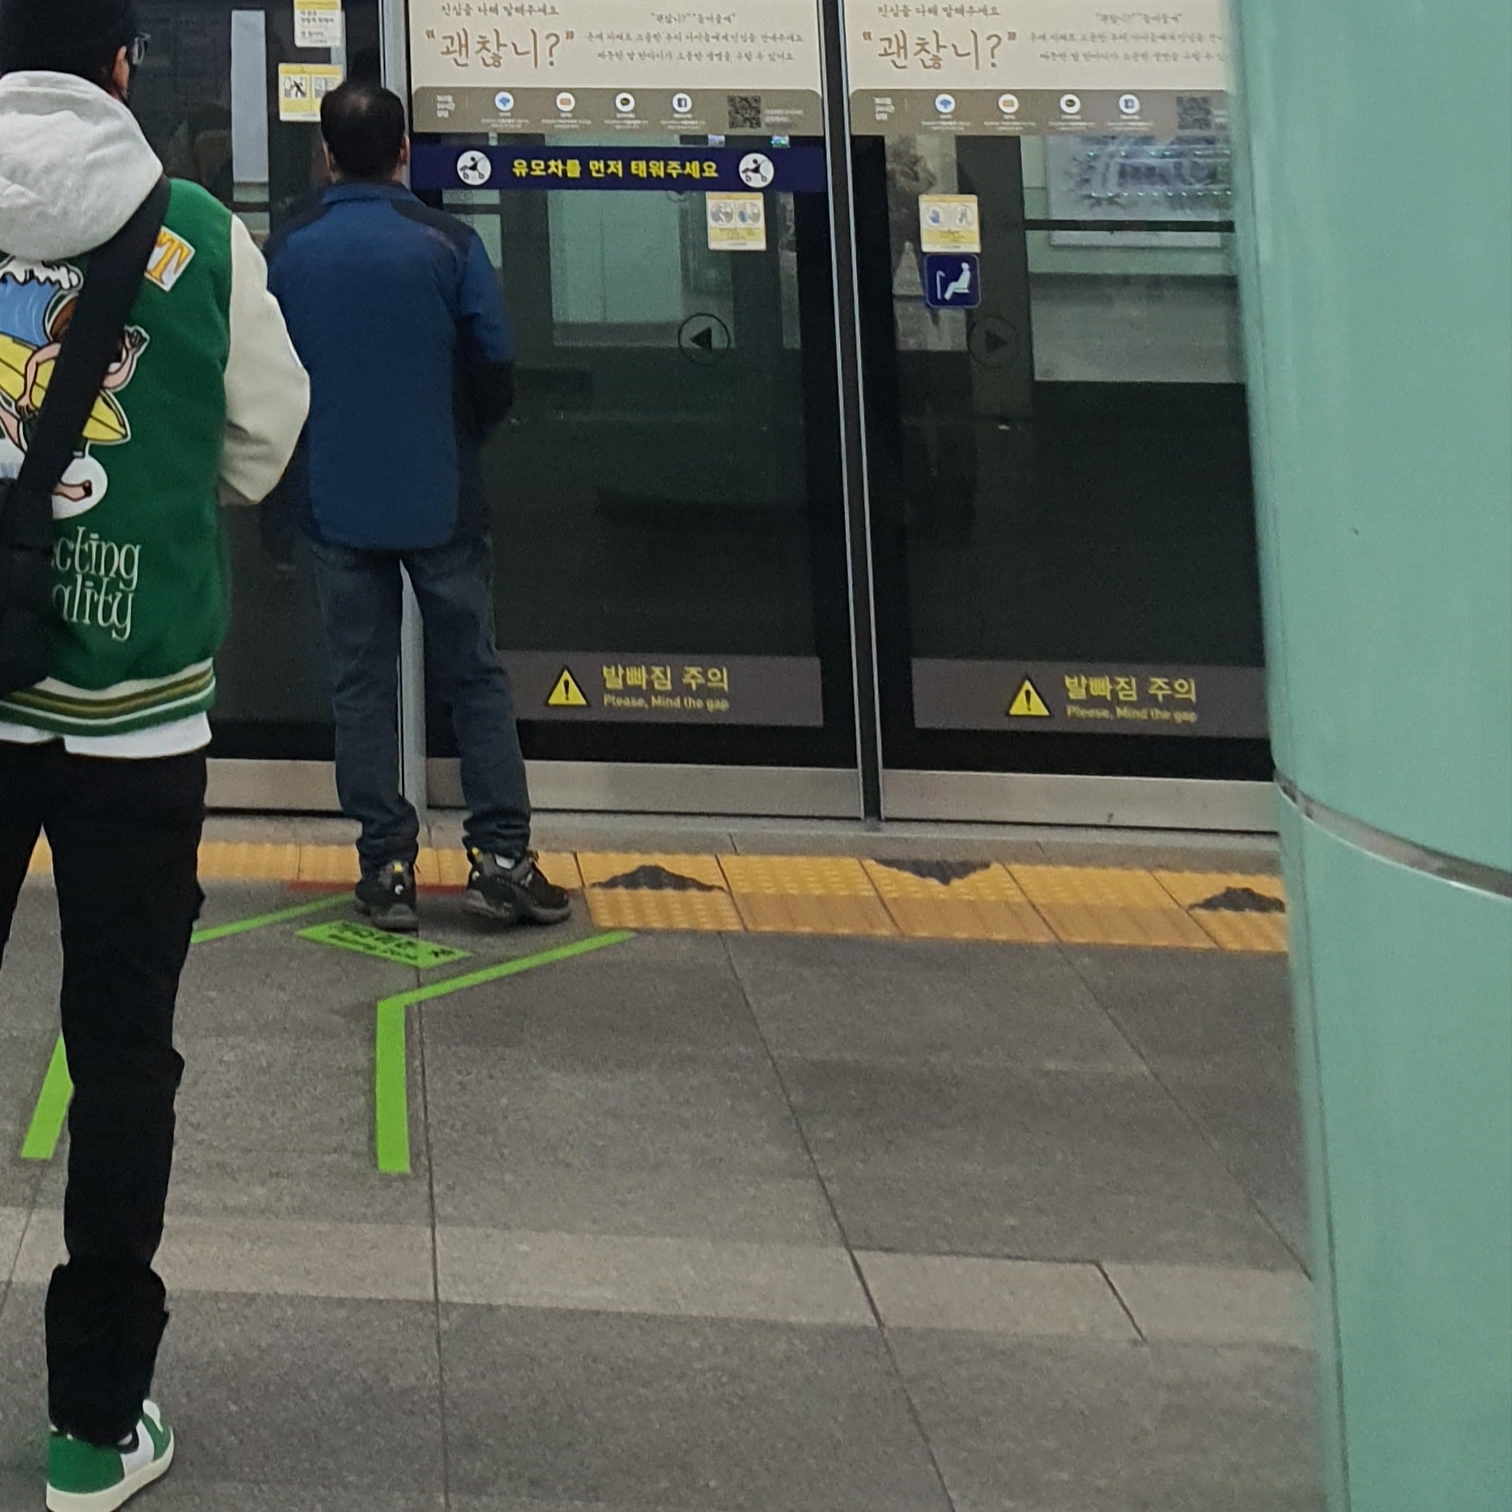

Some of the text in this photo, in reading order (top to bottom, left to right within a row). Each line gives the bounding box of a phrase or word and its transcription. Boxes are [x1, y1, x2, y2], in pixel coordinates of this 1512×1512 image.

[512, 159, 719, 179] 유모차를 먼저 태워주세요
[51, 526, 142, 591] cting
[603, 664, 729, 692] 발빠짐 주의
[1064, 674, 1197, 704] 발빠짐 주의
[603, 693, 730, 713] Please, Mind the gap
[1067, 704, 1198, 725] Please, Mind the gap
